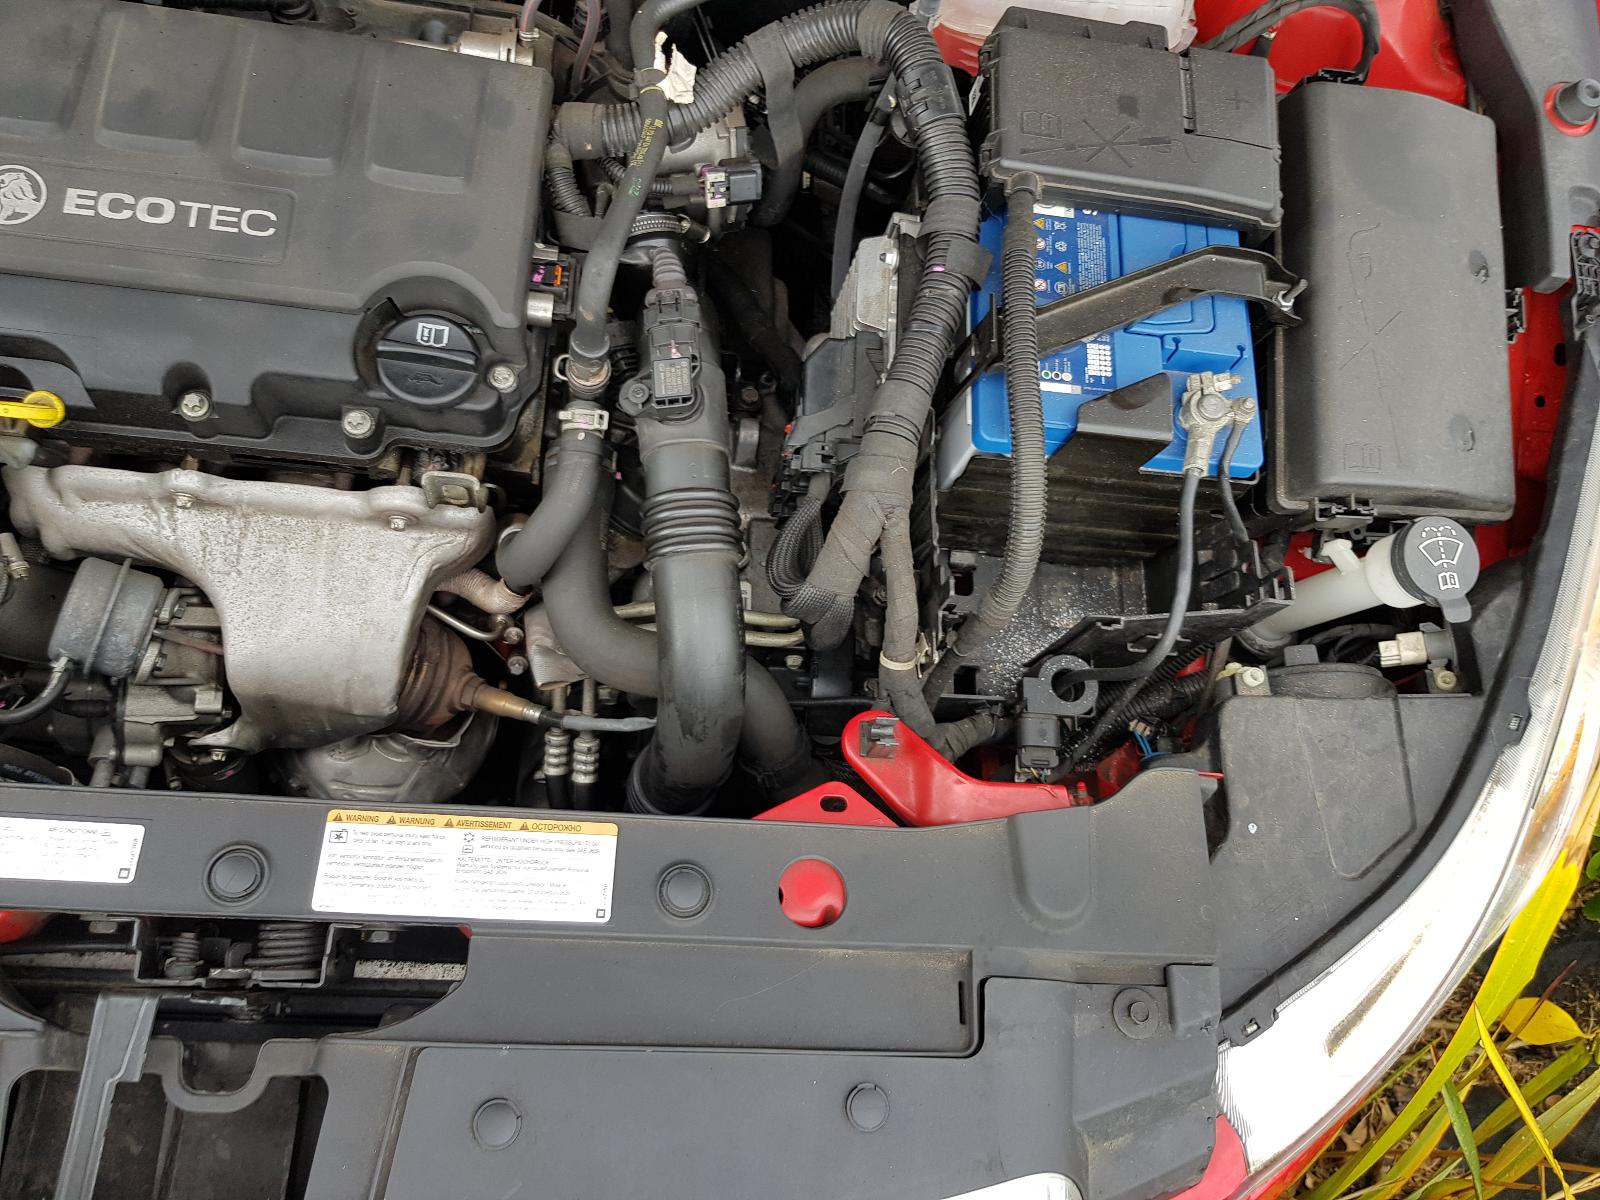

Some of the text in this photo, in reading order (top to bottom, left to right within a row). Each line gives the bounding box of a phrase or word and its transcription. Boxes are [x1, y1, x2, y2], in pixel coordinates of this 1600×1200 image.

[62, 187, 278, 237] ECOTEC
[346, 814, 512, 829] WARNING WARNUNG AVERTISSEMENT
[531, 822, 582, 832] ОСТОРОЖНО
